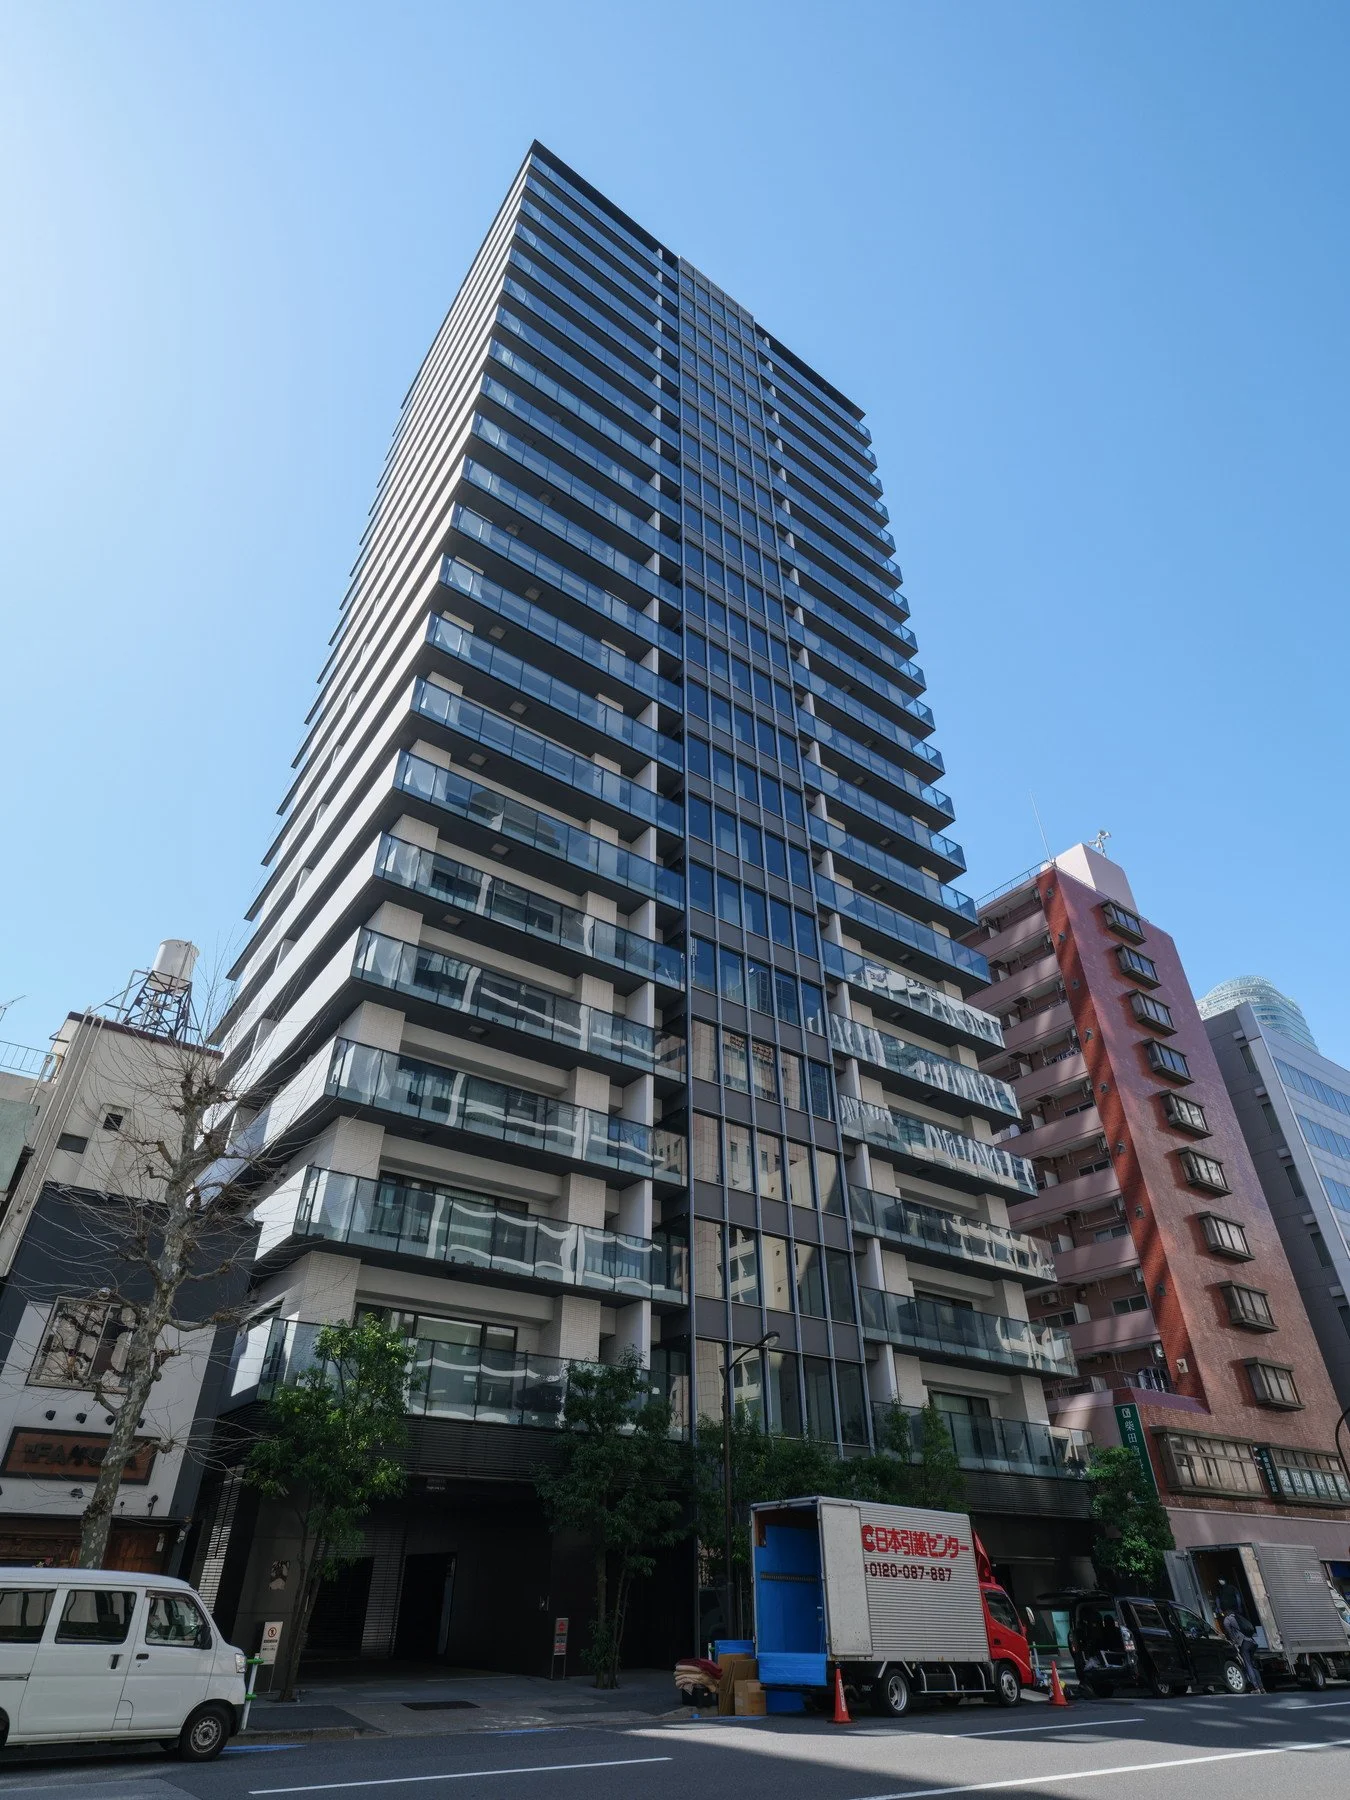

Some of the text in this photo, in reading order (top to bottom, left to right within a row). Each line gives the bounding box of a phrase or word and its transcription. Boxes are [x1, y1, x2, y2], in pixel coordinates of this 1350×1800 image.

[875, 1527, 969, 1558] 日本引越センター
[870, 1562, 952, 1581] 0120-087-887
